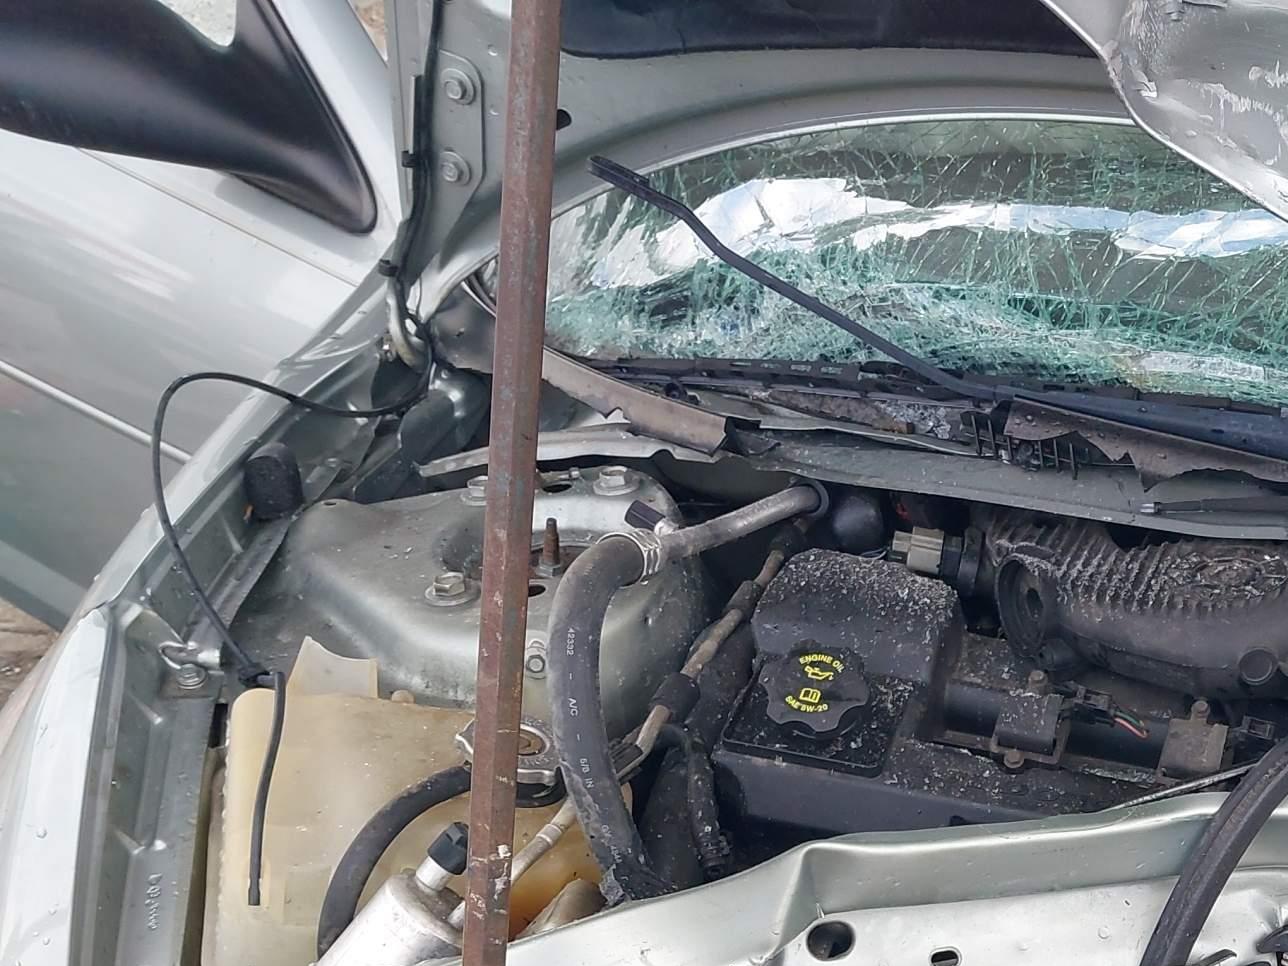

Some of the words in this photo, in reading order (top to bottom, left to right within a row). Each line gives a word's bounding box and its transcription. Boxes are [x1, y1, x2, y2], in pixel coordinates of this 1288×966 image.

[799, 653, 834, 666] ENGINE
[832, 659, 846, 674] OIL
[785, 695, 800, 711] SAE
[567, 697, 579, 717] A/C
[584, 777, 595, 789] IN
